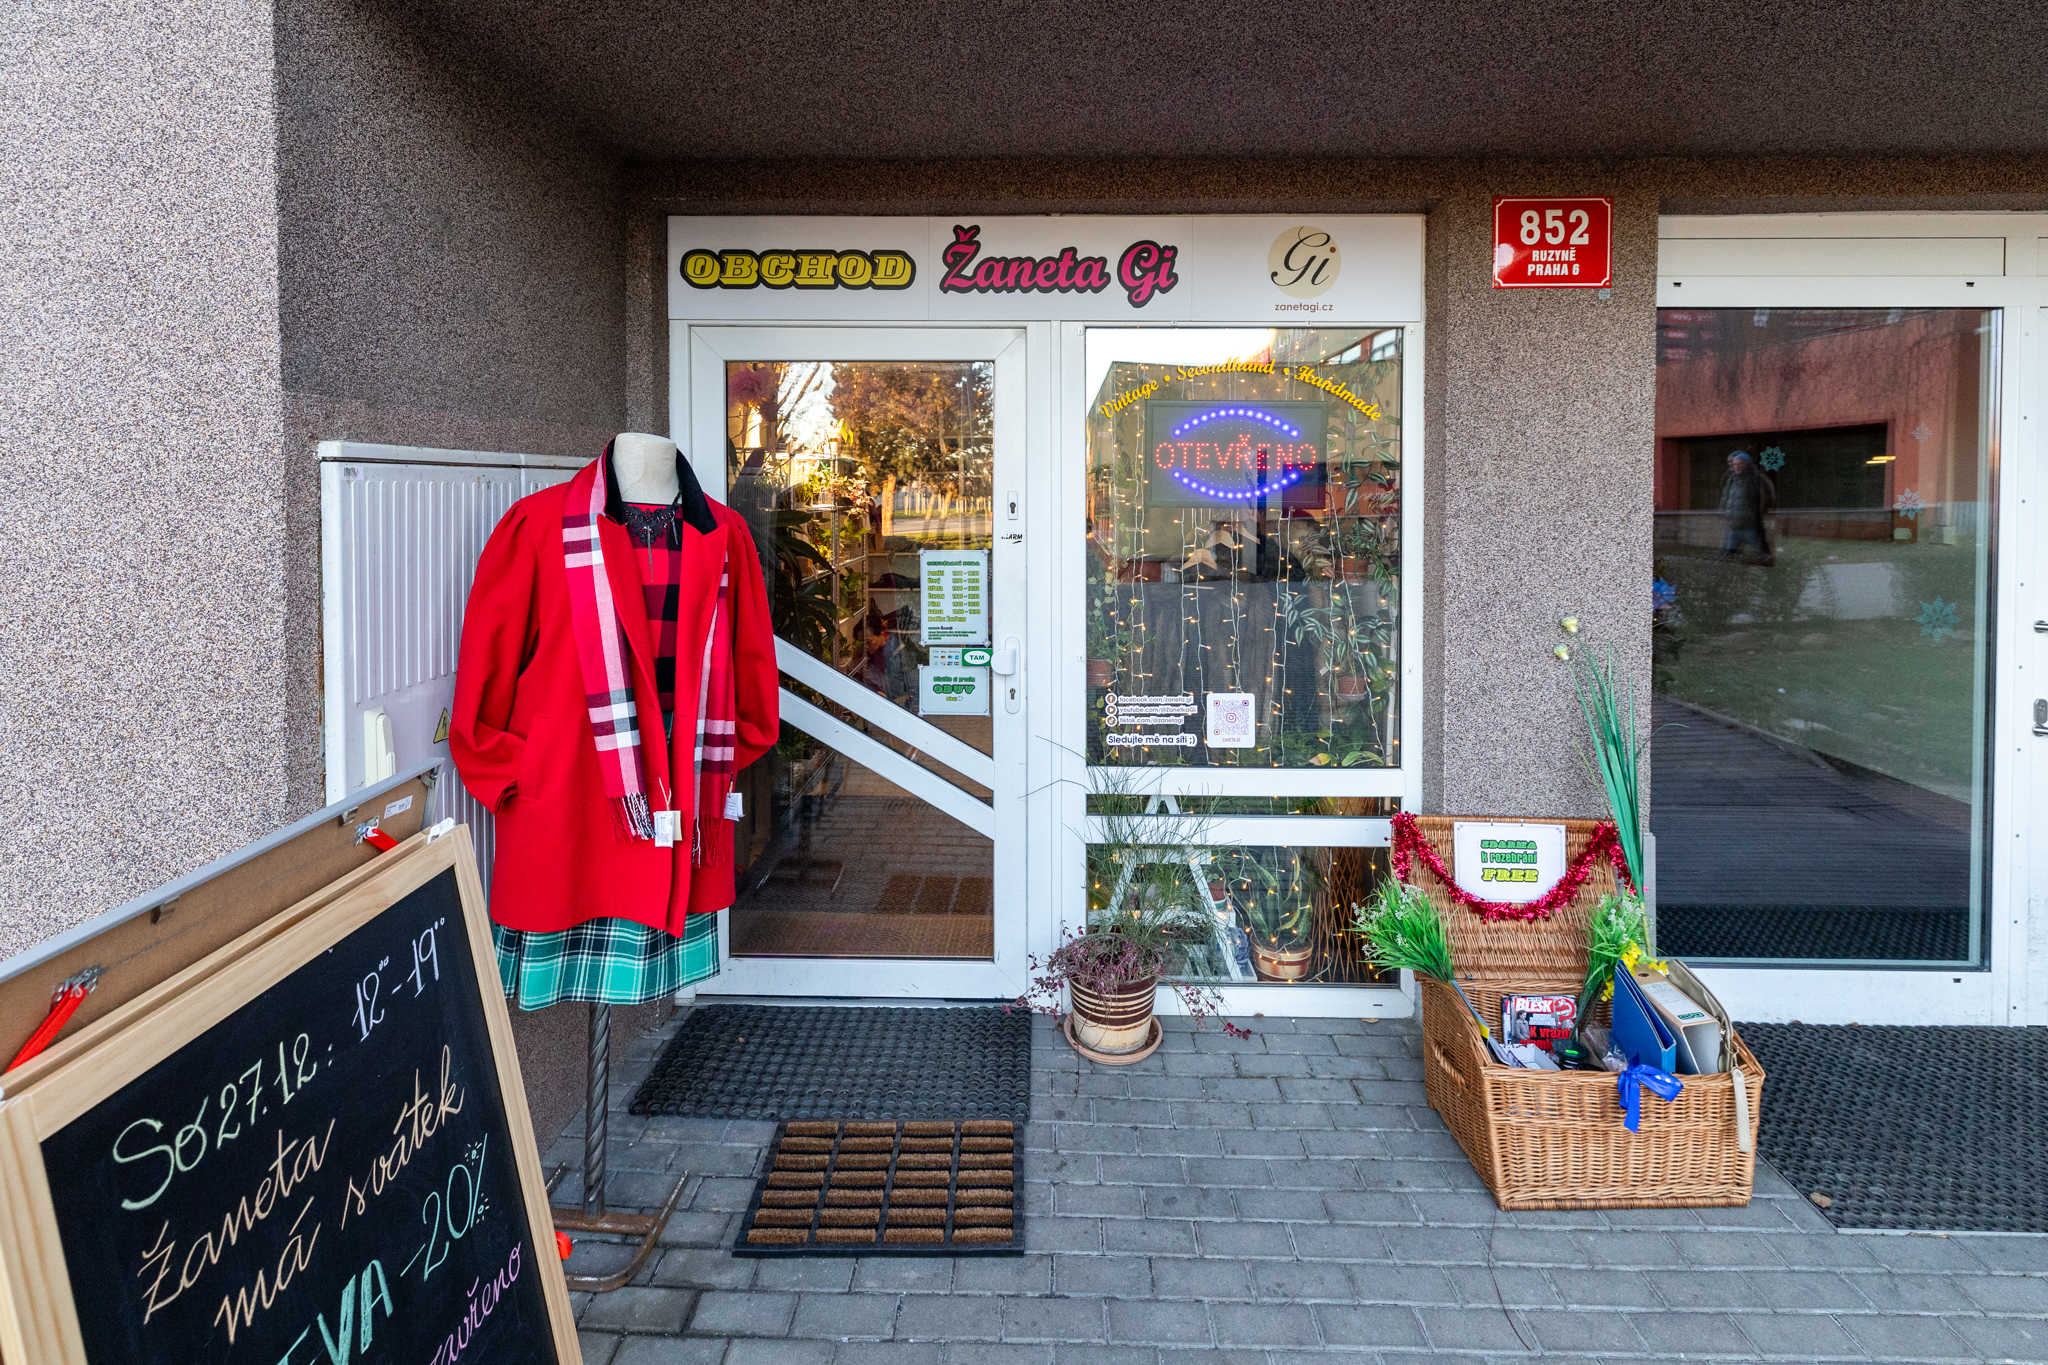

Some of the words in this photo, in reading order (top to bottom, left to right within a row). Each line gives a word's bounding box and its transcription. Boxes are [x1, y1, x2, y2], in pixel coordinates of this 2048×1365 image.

[1520, 209, 1589, 245] 852
[1271, 226, 1336, 286] Gi
[1532, 247, 1576, 261] RUZYNĚ
[682, 251, 915, 288] OBCHOD
[942, 226, 1109, 291] Žaneta
[1119, 242, 1176, 305] Gi
[1527, 263, 1569, 276] PRAHA
[1572, 263, 1580, 276] 6
[1275, 302, 1333, 313] zanetagi.cz
[1100, 380, 1159, 418] Vintage
[1177, 357, 1275, 381] Secondhand
[1294, 365, 1381, 421] Handmade
[1155, 434, 1317, 470] OTEVŘENO
[933, 684, 975, 694] OBUV
[1119, 696, 1192, 704] facebook.com/zaneta.gi
[1120, 716, 1184, 725] tiktok.com/@zanetagi
[1108, 735, 1143, 745] Sledujte
[1146, 735, 1160, 743] mě
[1175, 734, 1188, 743] síti
[1481, 840, 1537, 849] ZDARMA
[1481, 851, 1488, 863] k
[1490, 851, 1537, 864] rozebrání
[1482, 868, 1539, 882] FREE
[1515, 998, 1553, 1012] BLESK
[1530, 1026, 1538, 1038] K
[1539, 1027, 1570, 1039] vražd
[214, 1195, 321, 1344] má
[341, 1044, 465, 1230] svátek
[137, 1118, 336, 1324] Žaneta
